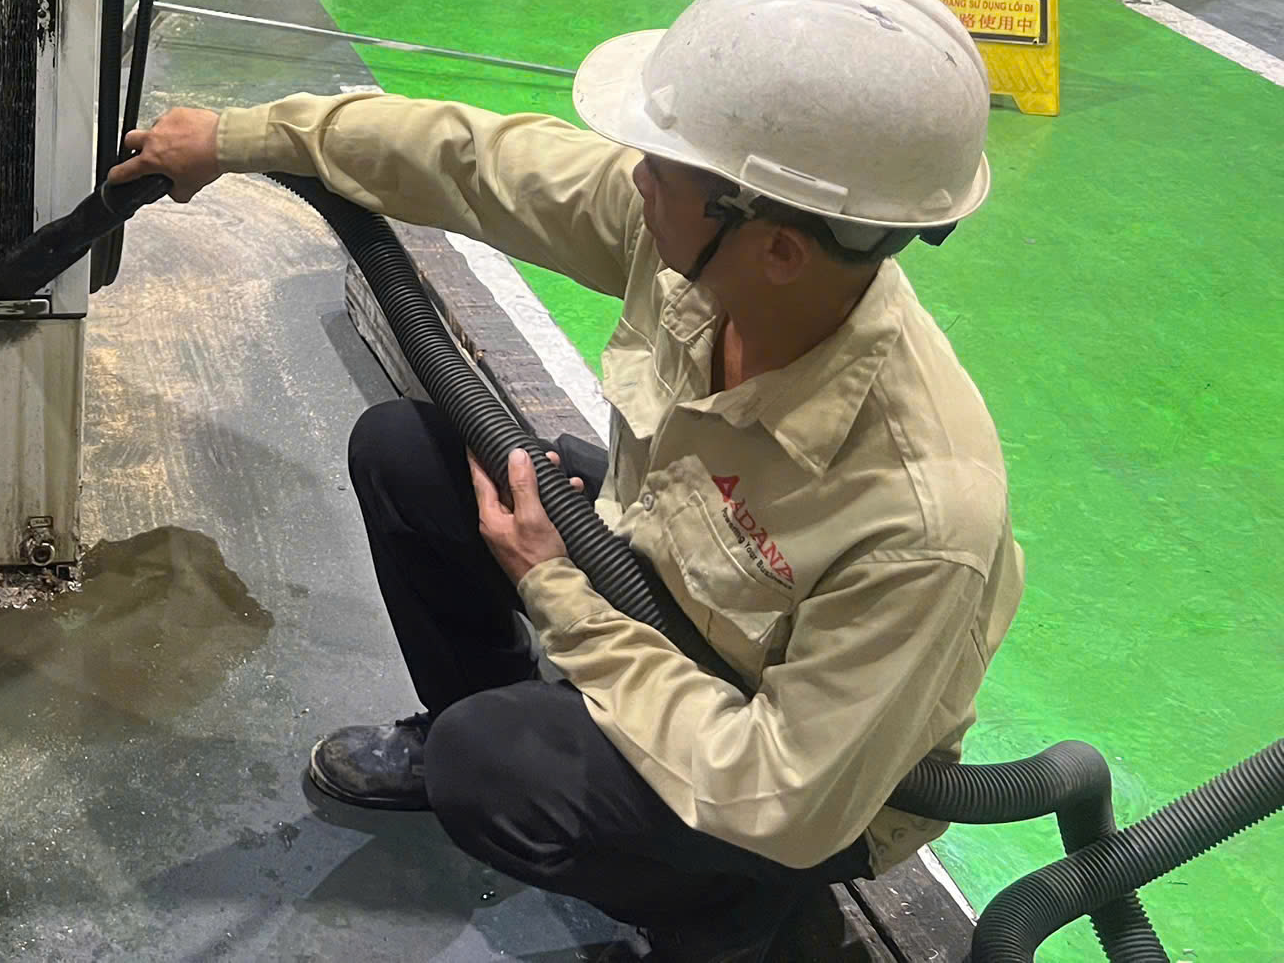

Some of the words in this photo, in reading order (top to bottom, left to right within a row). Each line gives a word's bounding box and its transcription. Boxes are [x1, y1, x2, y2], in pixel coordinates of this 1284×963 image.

[959, 13, 1032, 34] 路使用中
[729, 498, 796, 585] ADANA
